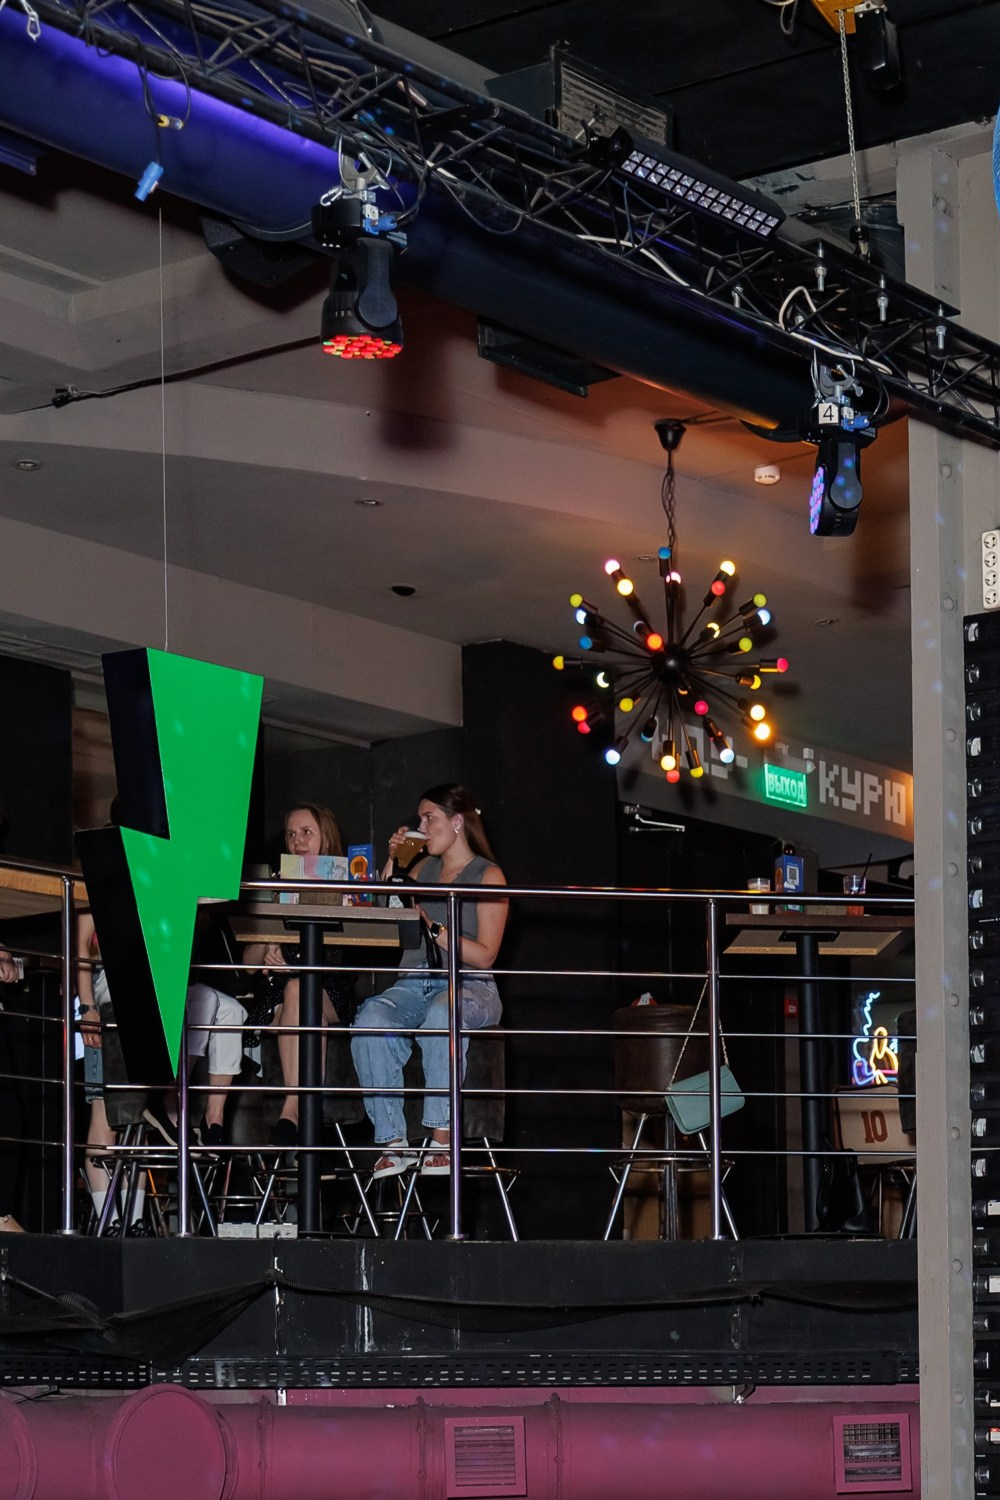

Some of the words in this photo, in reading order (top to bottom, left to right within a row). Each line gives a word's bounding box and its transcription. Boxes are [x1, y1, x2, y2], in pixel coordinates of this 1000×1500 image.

[823, 404, 834, 421] 4
[767, 772, 806, 803] ВЫХОД
[819, 760, 906, 826] КУРЮ
[861, 1110, 888, 1144] 10
